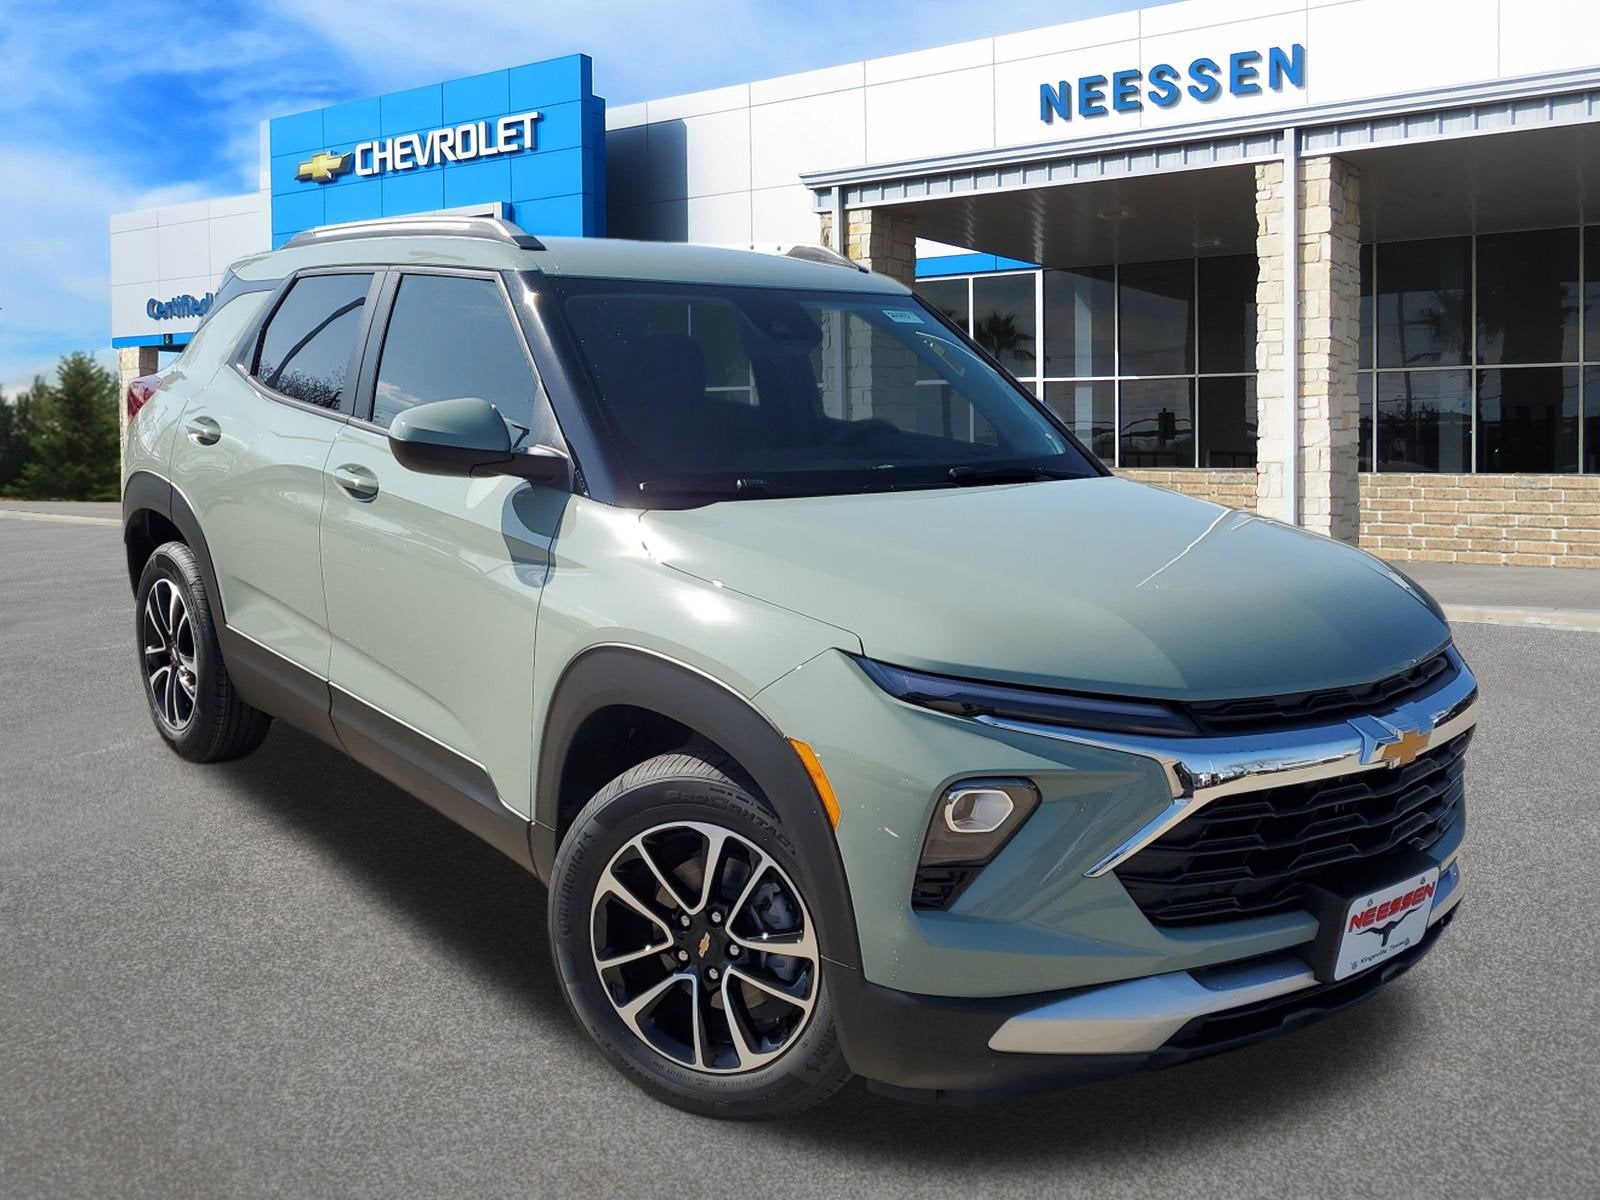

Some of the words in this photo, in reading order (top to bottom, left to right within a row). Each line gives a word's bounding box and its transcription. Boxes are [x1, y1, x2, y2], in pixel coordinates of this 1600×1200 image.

[1040, 43, 1305, 122] NEESSEN
[354, 110, 540, 176] CHEVROLET
[147, 292, 213, 320] Certified
[1349, 881, 1435, 933] NEESSEN
